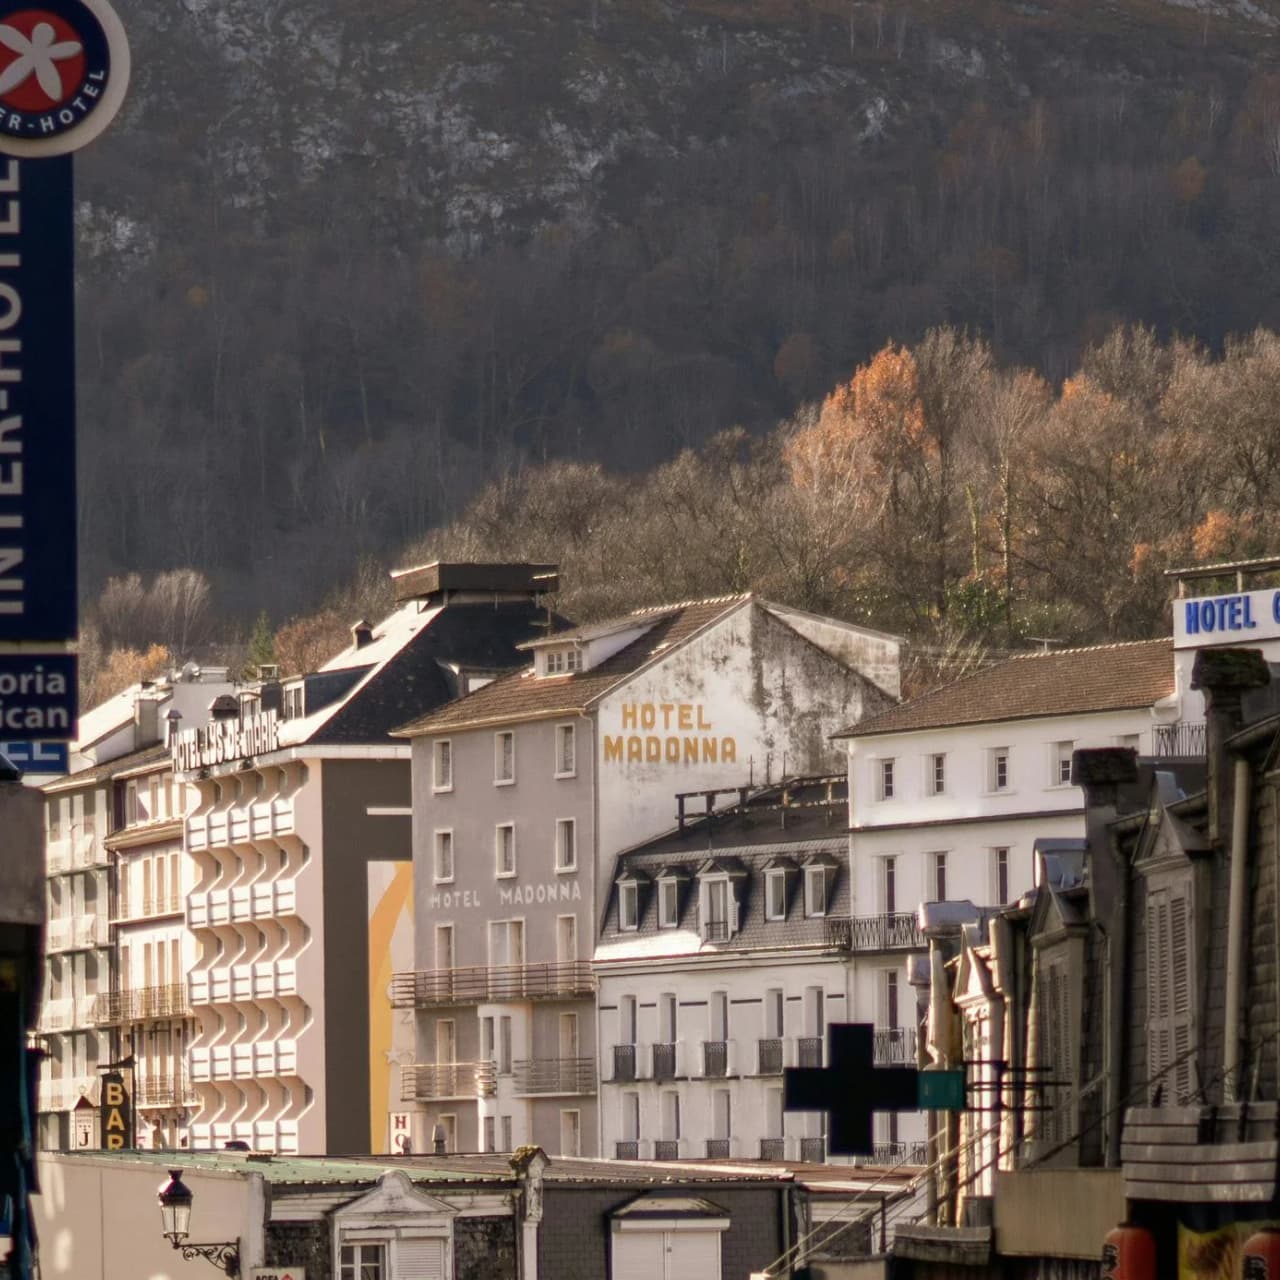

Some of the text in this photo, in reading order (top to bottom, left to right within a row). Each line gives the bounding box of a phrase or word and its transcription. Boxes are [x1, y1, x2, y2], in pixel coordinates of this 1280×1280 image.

[1185, 595, 1257, 635] HOTEL
[621, 703, 712, 731] HOTEL
[171, 728, 201, 772] HOTEL
[603, 735, 737, 764] MADONNA
[431, 880, 582, 909] HOTEL MADONNA
